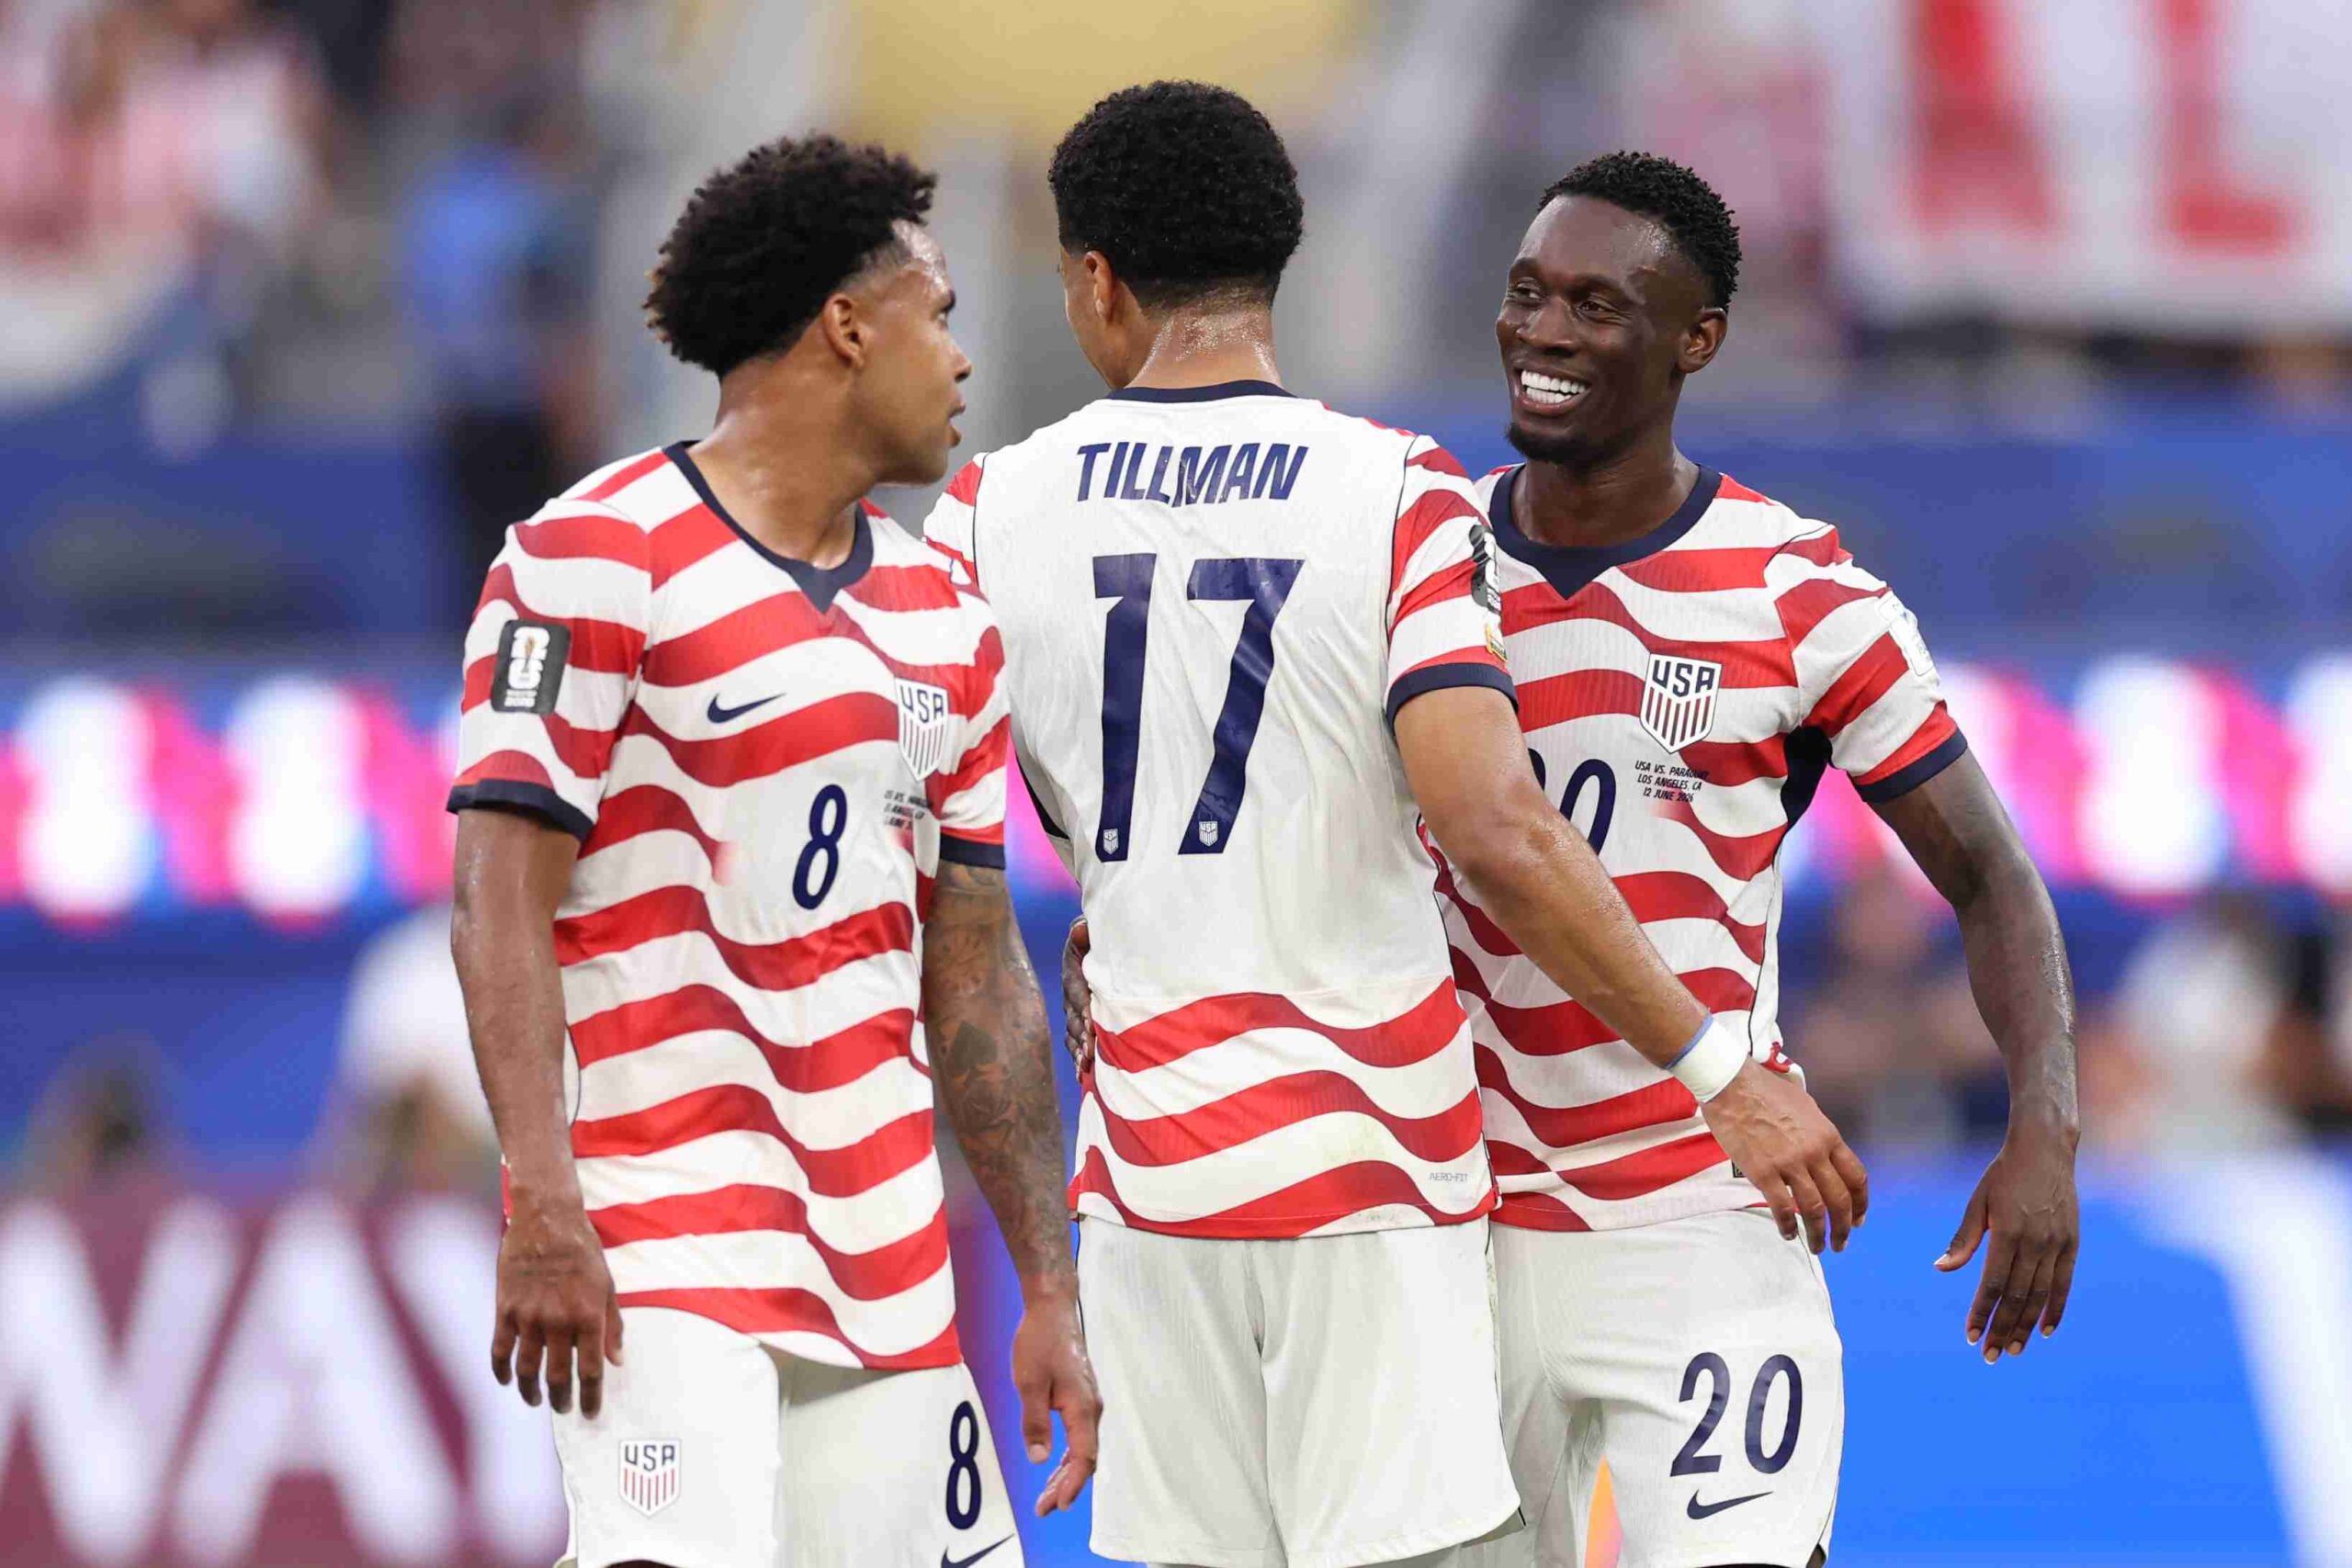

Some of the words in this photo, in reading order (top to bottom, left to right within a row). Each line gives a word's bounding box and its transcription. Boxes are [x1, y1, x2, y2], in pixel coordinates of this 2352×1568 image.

[1077, 442, 1309, 507] TILLMAN
[899, 684, 944, 724] USA
[1653, 660, 1715, 697] USA
[1092, 553, 1306, 863] 17
[1634, 760, 1651, 772] USA
[1637, 773, 1653, 784] LOS
[1692, 782, 1702, 791] CA
[1527, 748, 1617, 856] 0
[1643, 787, 1652, 796] 12
[1654, 789, 1676, 800] JUNE
[793, 784, 847, 910] 8
[1669, 1351, 1803, 1477] 20
[625, 1444, 675, 1472] USA
[945, 1400, 982, 1530] 8
